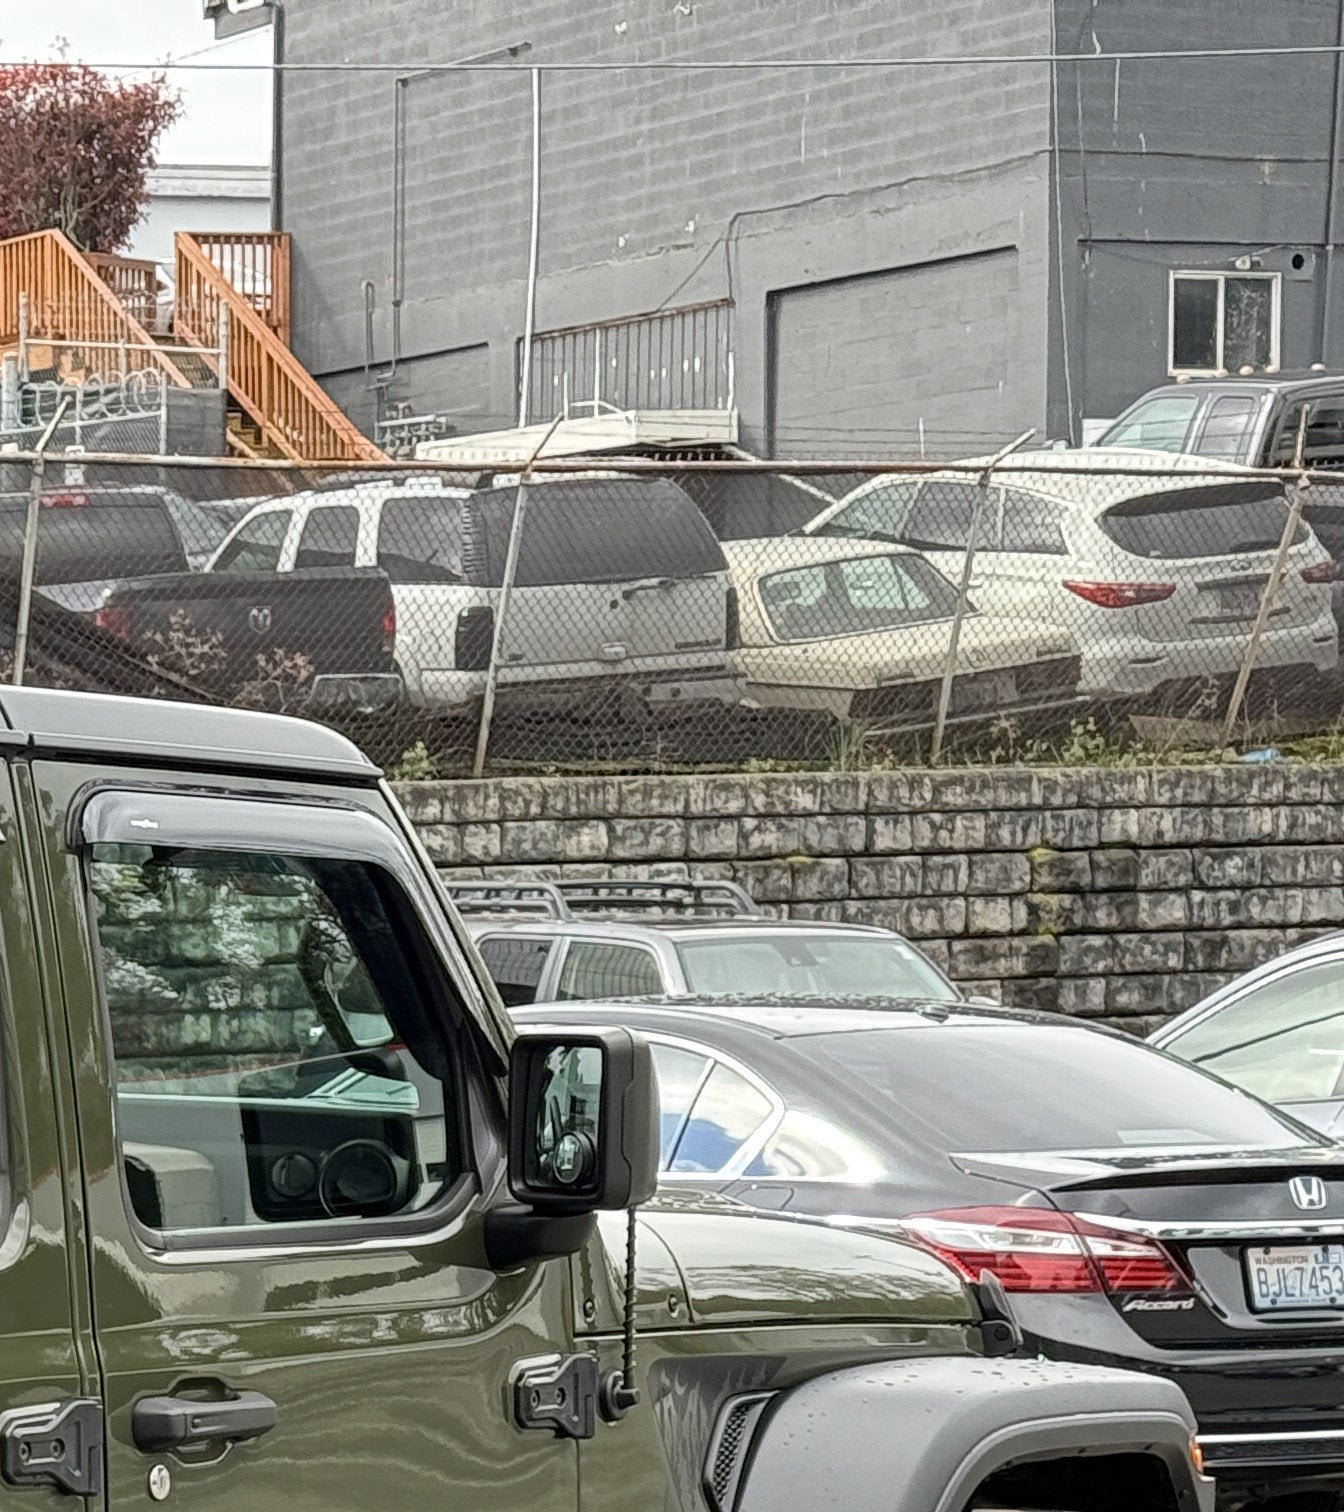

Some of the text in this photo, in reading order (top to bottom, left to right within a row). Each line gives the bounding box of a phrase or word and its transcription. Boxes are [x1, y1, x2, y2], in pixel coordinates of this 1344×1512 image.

[1254, 1254, 1309, 1265] WASHINGTON
[1256, 1264, 1344, 1298] BJL7453
[1123, 1297, 1196, 1312] Accord
